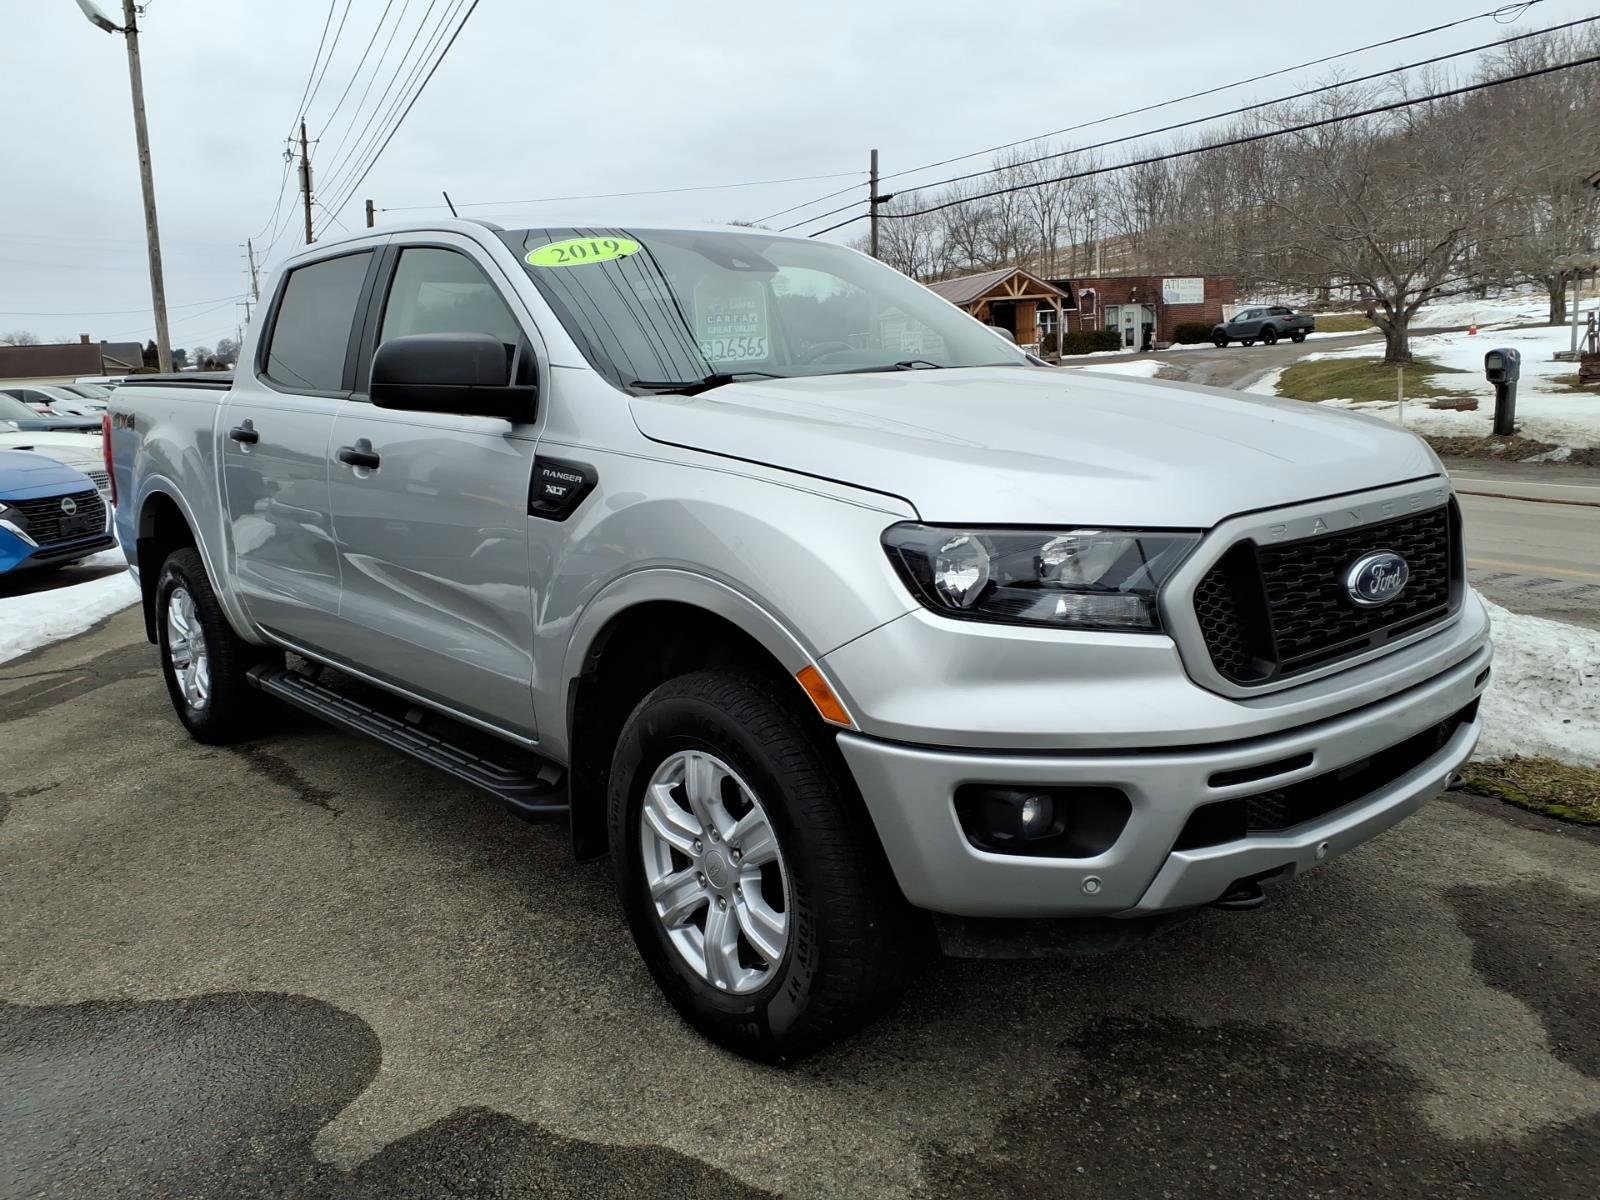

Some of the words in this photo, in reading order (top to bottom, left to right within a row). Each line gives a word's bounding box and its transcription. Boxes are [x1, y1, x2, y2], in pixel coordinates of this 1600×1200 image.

[550, 239, 619, 263] 2019
[706, 313, 758, 324] CARFAX
[542, 469, 583, 483] RANGER
[545, 484, 567, 496] XLT
[1370, 562, 1401, 594] Ford
